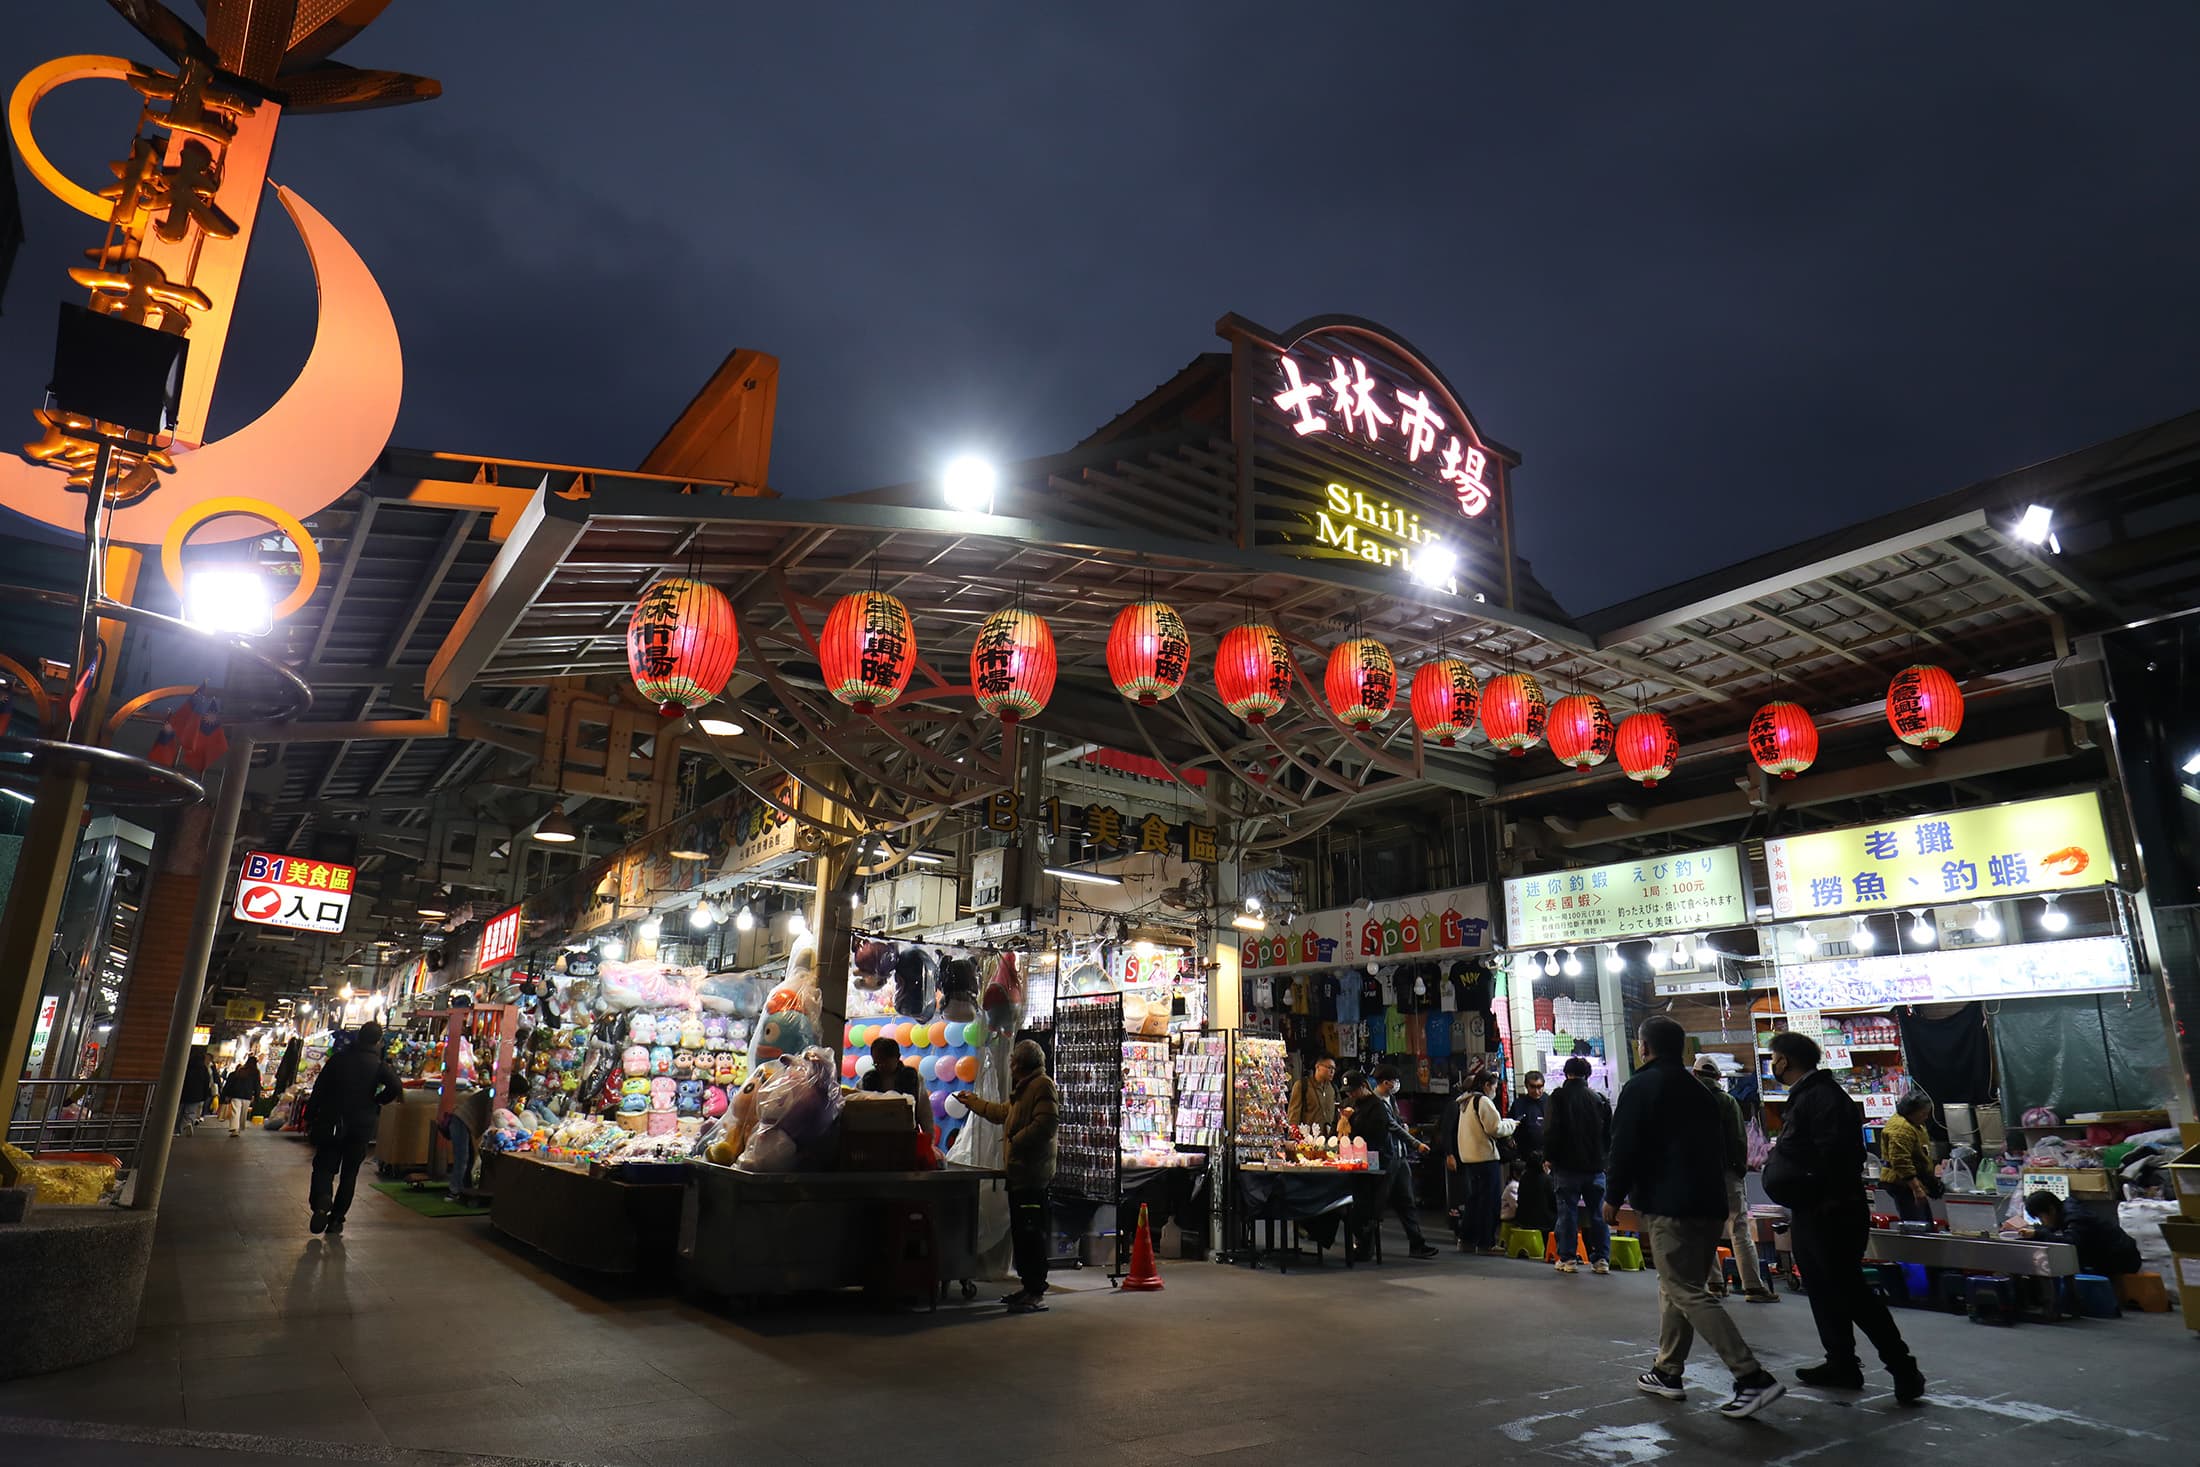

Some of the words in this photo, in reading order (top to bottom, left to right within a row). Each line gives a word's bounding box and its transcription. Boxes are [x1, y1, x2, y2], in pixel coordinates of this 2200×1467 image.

[1273, 355, 1491, 517] 士林市場
[632, 585, 688, 676] 士林市場
[976, 618, 1018, 693] 士林市場
[1449, 665, 1477, 727] 士林市場
[1751, 712, 1780, 761] 士林市場
[1864, 820, 1954, 860] 老攤
[1526, 871, 1608, 898] 迷你釣蝦
[1632, 856, 1712, 883] えび釣り
[1810, 852, 2031, 908] 撈魚、釣蝦
[284, 896, 343, 924] 入口
[1244, 937, 1314, 967] Sport
[1364, 918, 1456, 955] Sport
